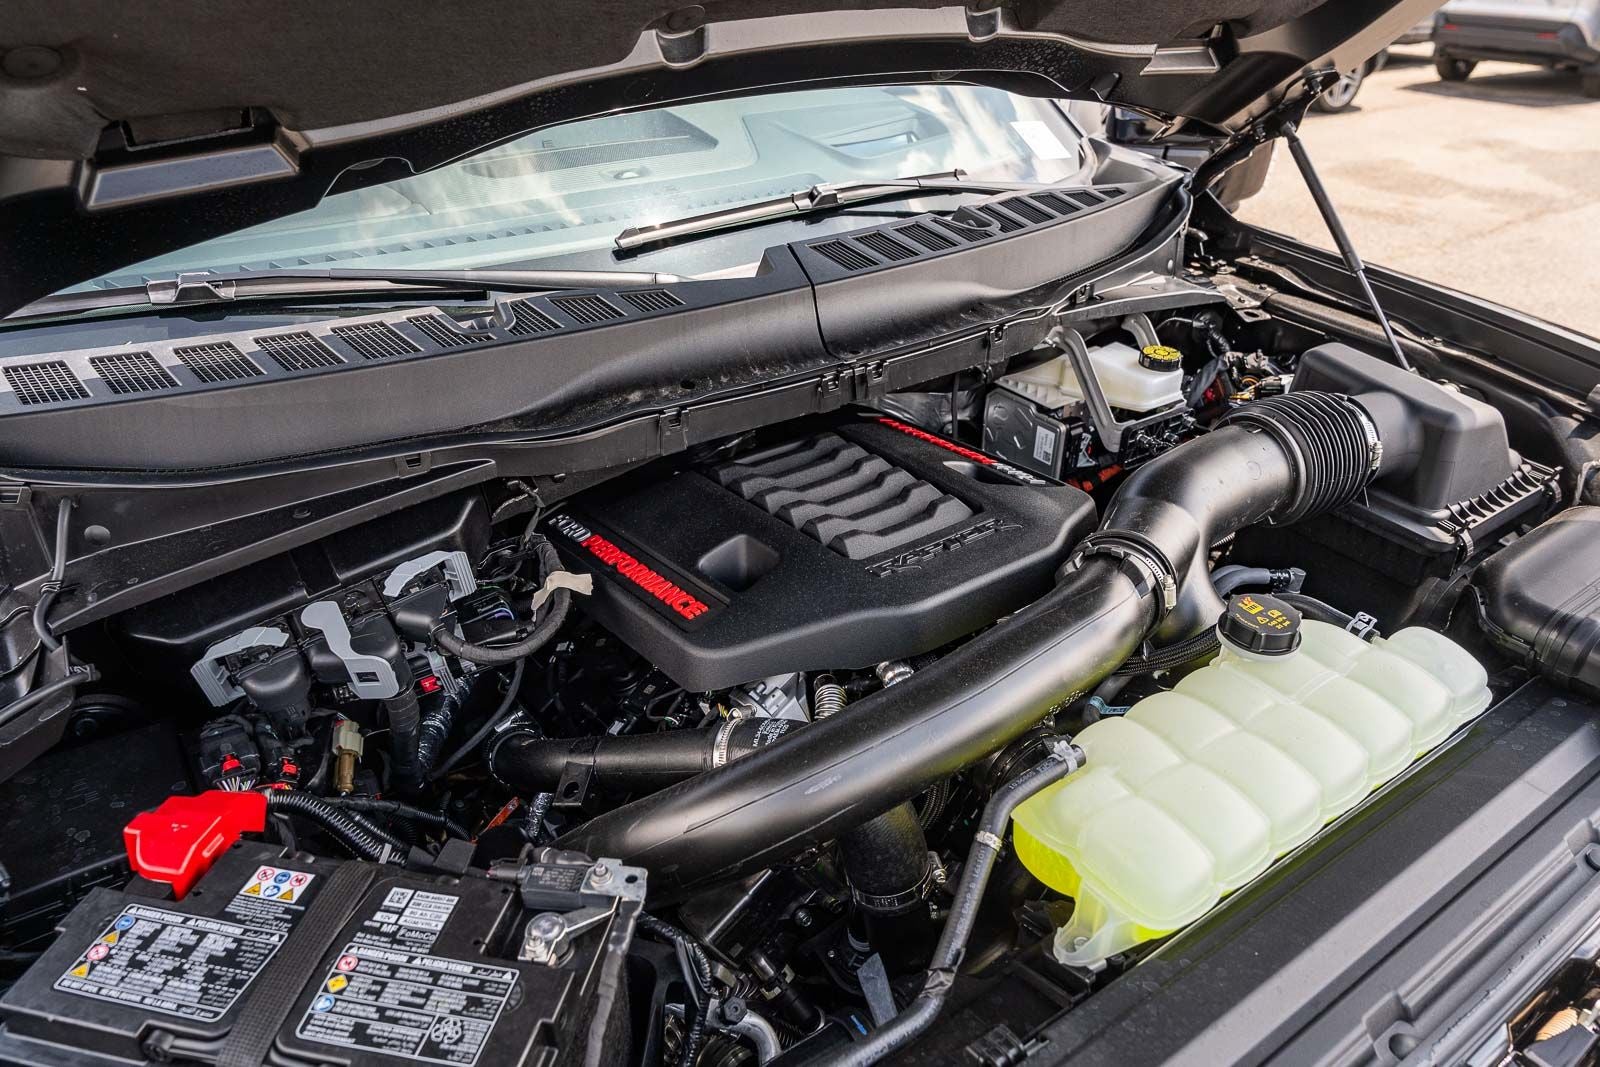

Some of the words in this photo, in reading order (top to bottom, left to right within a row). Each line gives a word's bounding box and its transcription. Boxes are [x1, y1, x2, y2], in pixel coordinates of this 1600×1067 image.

[549, 514, 591, 542] FORD
[580, 534, 709, 620] PERFORMANCE
[400, 927, 437, 941] FoMoCo
